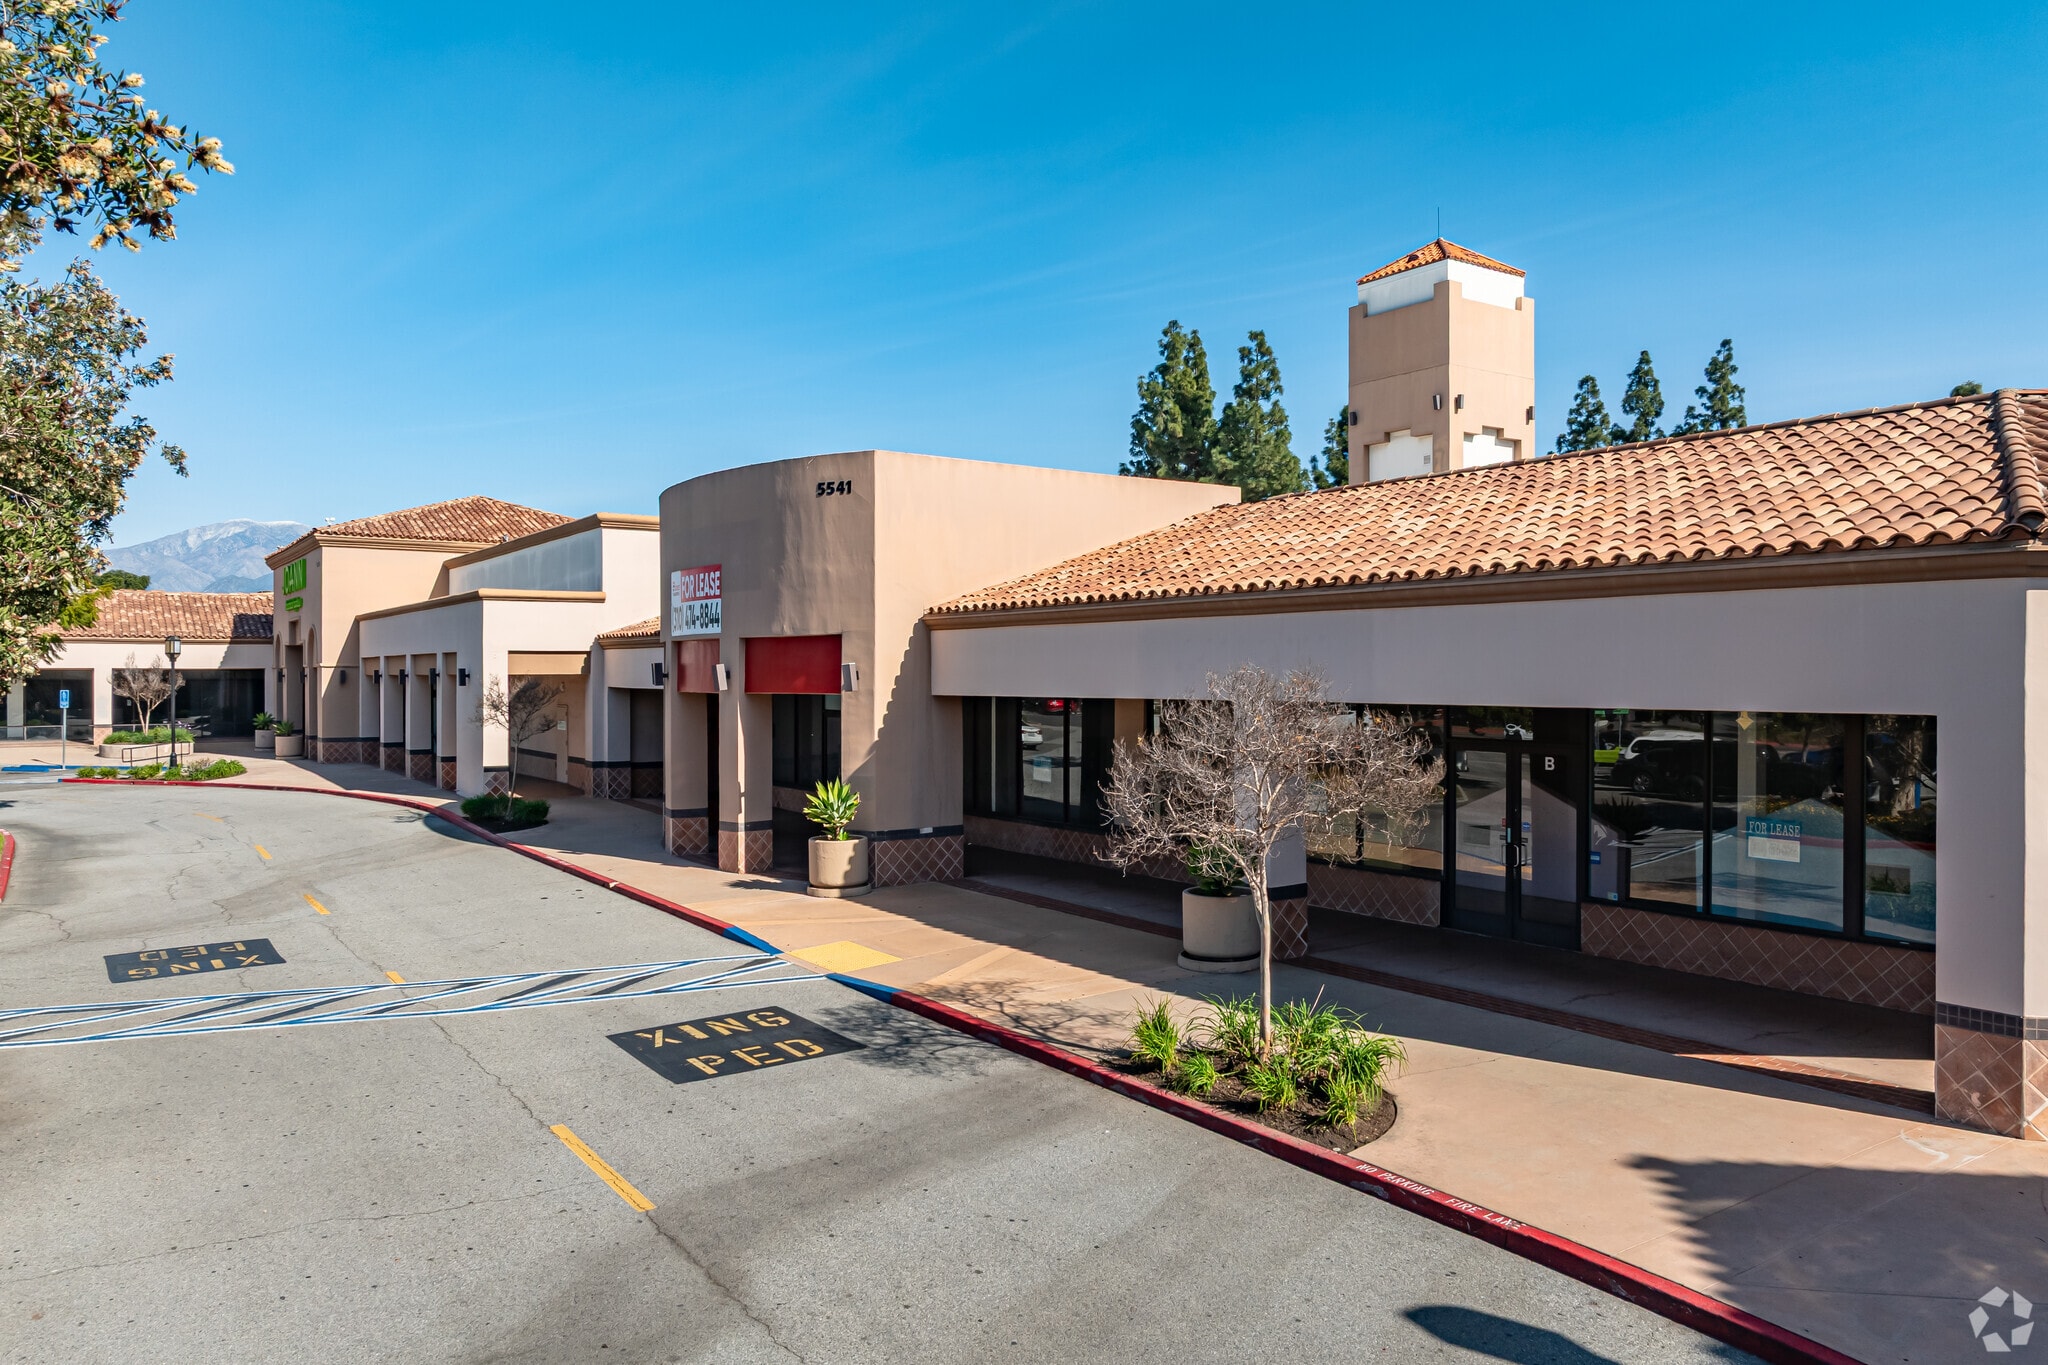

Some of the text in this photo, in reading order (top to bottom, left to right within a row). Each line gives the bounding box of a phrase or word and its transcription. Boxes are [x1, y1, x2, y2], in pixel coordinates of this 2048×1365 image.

[816, 480, 852, 498] 5541
[682, 575, 694, 599] FOR
[696, 571, 721, 597] LEASE
[685, 602, 720, 630] 474-8844
[1545, 756, 1555, 770] B
[1749, 821, 1800, 837] FOR LEASE
[635, 1011, 791, 1048] XING
[686, 1039, 825, 1075] PED
[1356, 1163, 1378, 1174] NO
[1379, 1172, 1435, 1196] PARKING
[1446, 1198, 1483, 1214] FIRE
